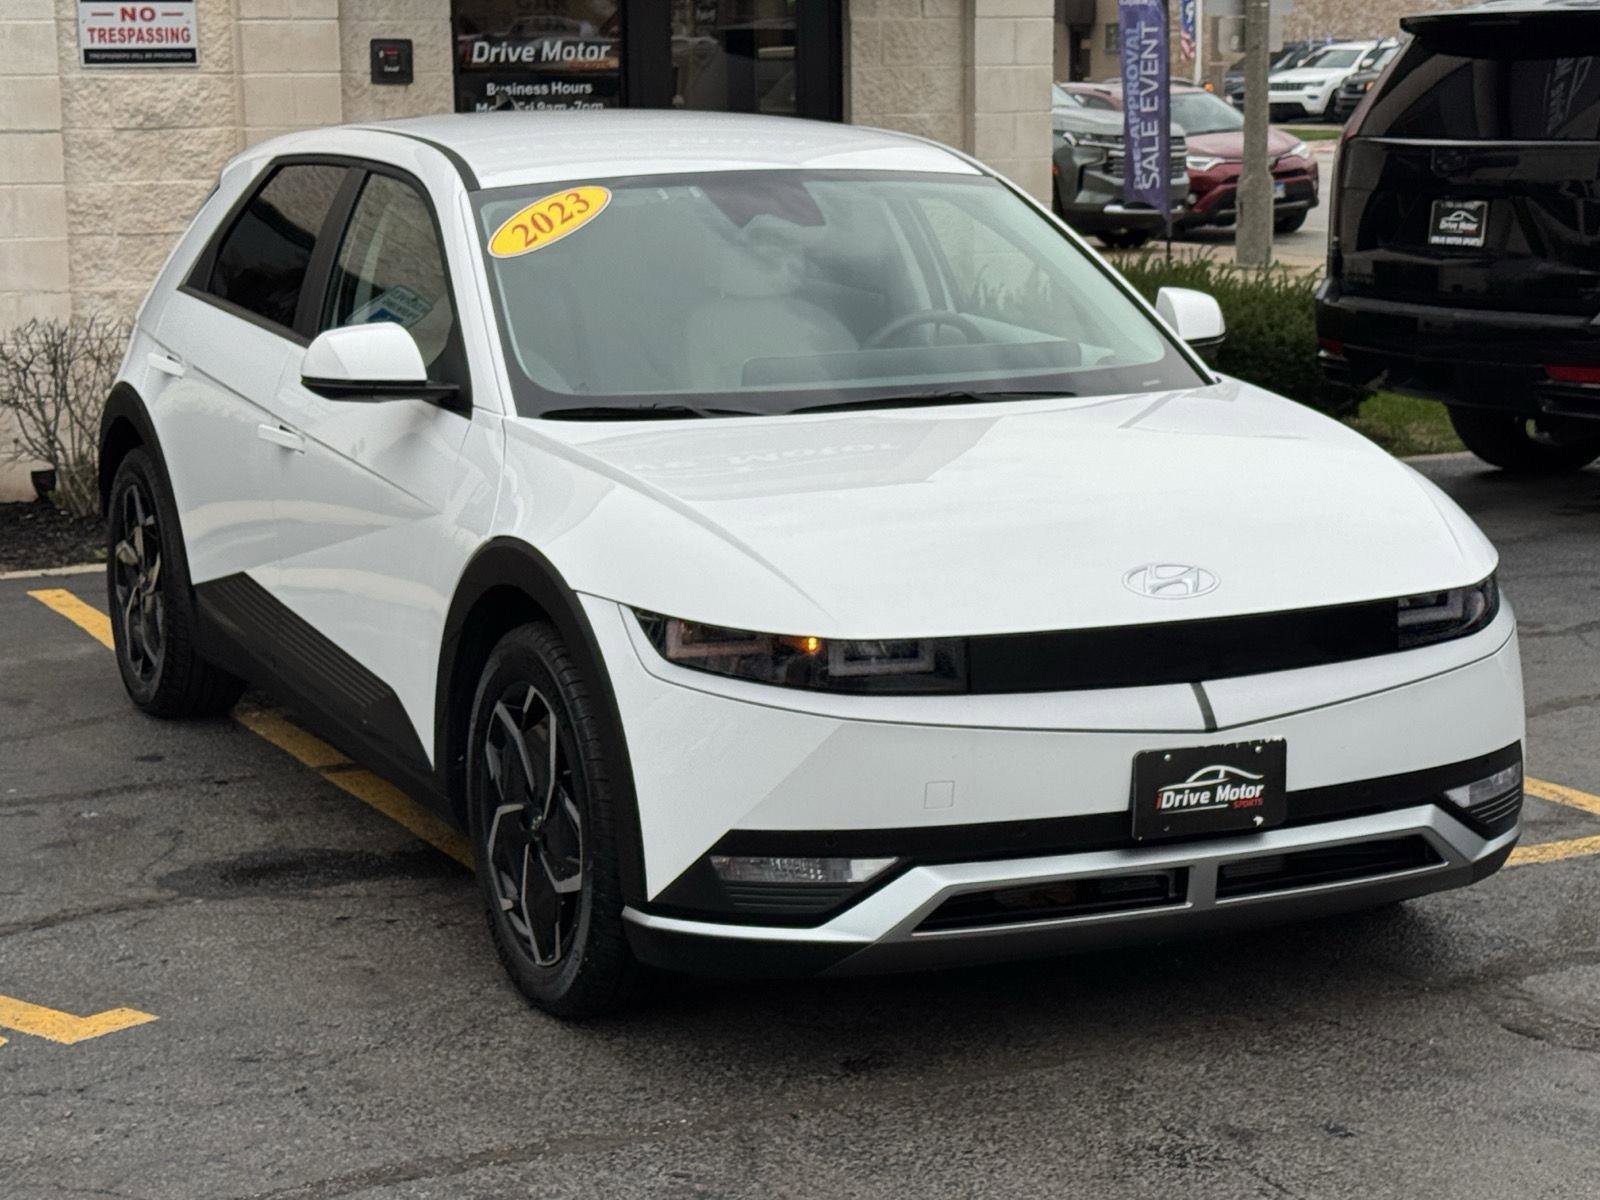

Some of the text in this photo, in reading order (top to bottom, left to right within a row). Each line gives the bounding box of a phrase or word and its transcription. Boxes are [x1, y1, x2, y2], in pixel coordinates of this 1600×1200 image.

[119, 6, 156, 22] NO
[87, 27, 191, 44] TRESPASSING
[541, 40, 611, 62] Motor
[551, 81, 593, 95] Hours
[1139, 21, 1160, 190] SALE EVENT
[511, 192, 590, 248] 2023
[1155, 784, 1264, 811] iDrive Motor
[1233, 797, 1264, 809] SPORTS
